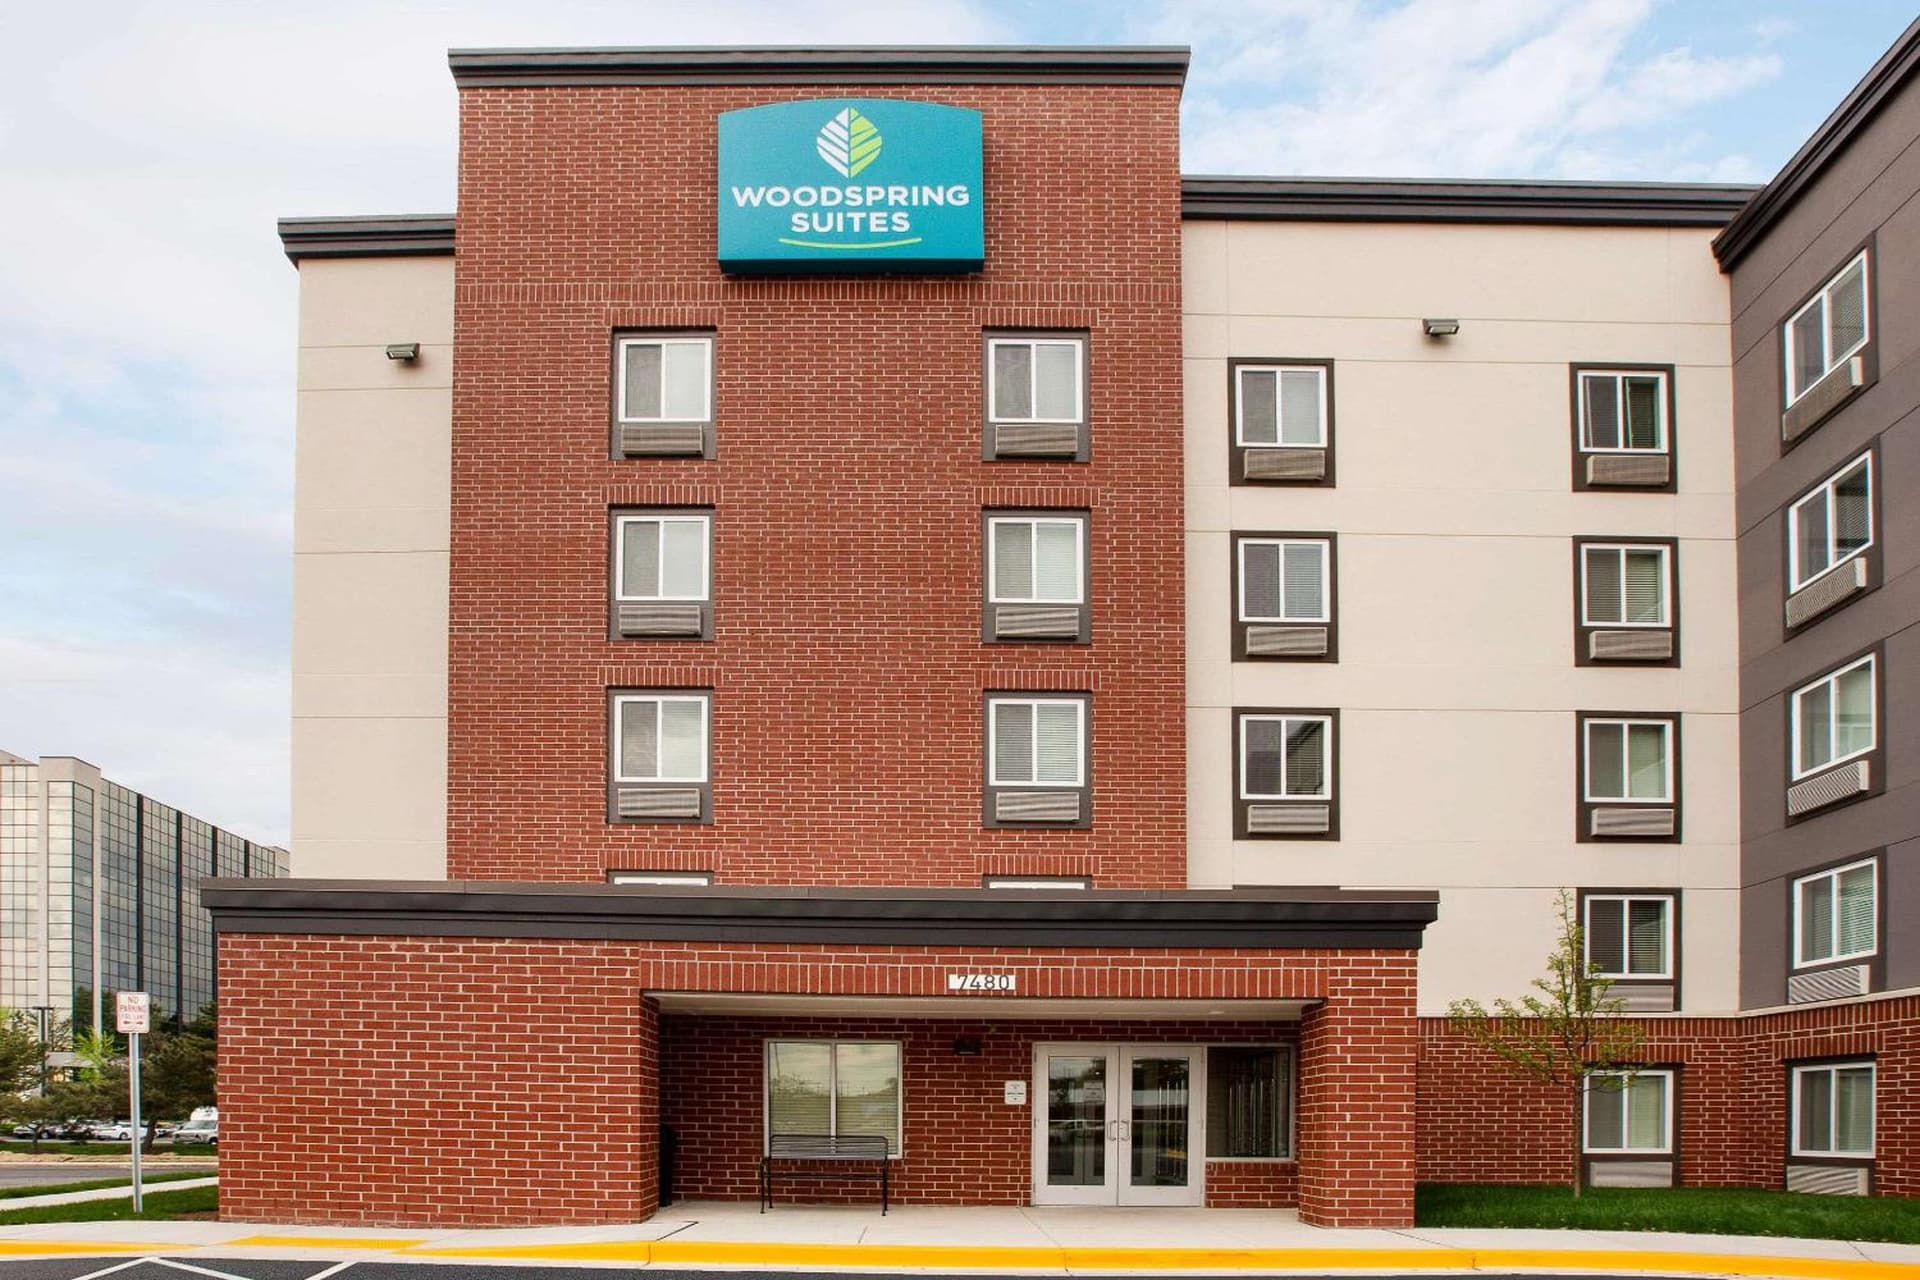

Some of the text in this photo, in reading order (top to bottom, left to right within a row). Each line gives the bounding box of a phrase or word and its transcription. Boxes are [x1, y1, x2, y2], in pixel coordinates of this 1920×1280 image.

[732, 185, 969, 207] WOODSPRING
[791, 212, 910, 232] SUITES
[957, 974, 1009, 990] 7480
[119, 1004, 147, 1012] PARKING
[127, 996, 139, 1004] NO
